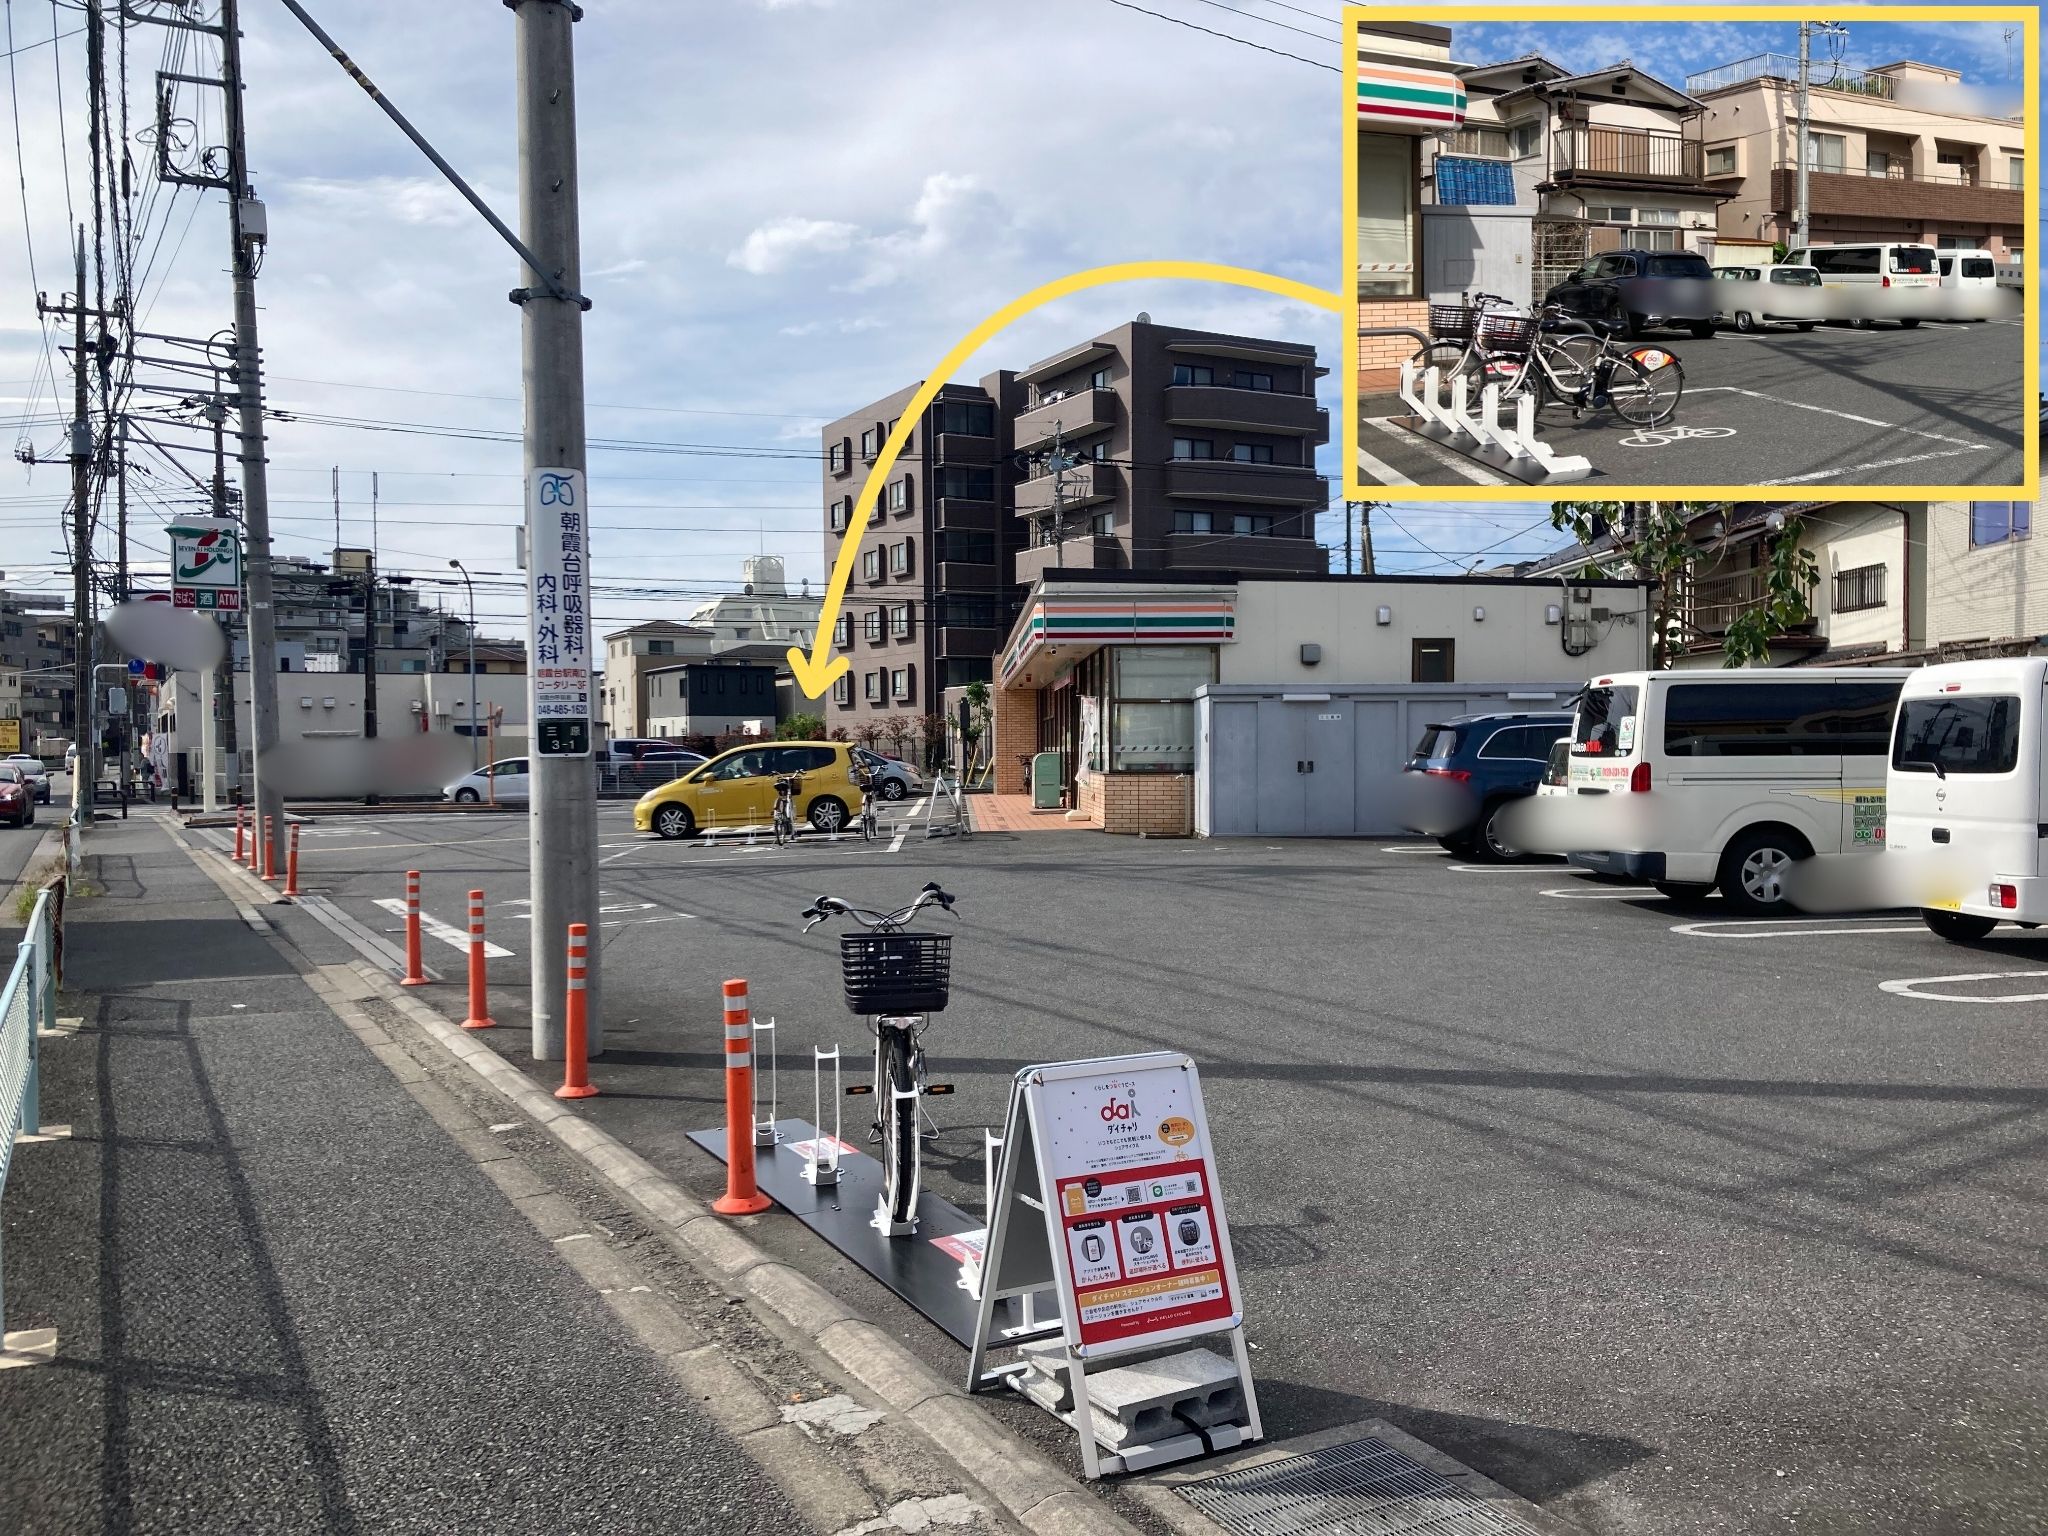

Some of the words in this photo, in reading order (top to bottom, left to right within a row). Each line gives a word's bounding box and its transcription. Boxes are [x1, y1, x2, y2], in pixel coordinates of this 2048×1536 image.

[204, 546, 233, 554] HOLDINGS
[174, 592, 195, 604] たばこ
[200, 592, 213, 605] 酒
[219, 593, 238, 605] ATM
[537, 573, 559, 665] 内科・外科
[537, 668, 587, 678] 朝霞台駅南口
[537, 680, 587, 690] ロータリー3F
[551, 739, 576, 750] 3-1
[1100, 1088, 1141, 1121] dai
[1107, 1121, 1138, 1135] ダイチャリ
[1081, 1271, 1116, 1284] かんたん予約
[1091, 1291, 1120, 1303] ダイチャリ
